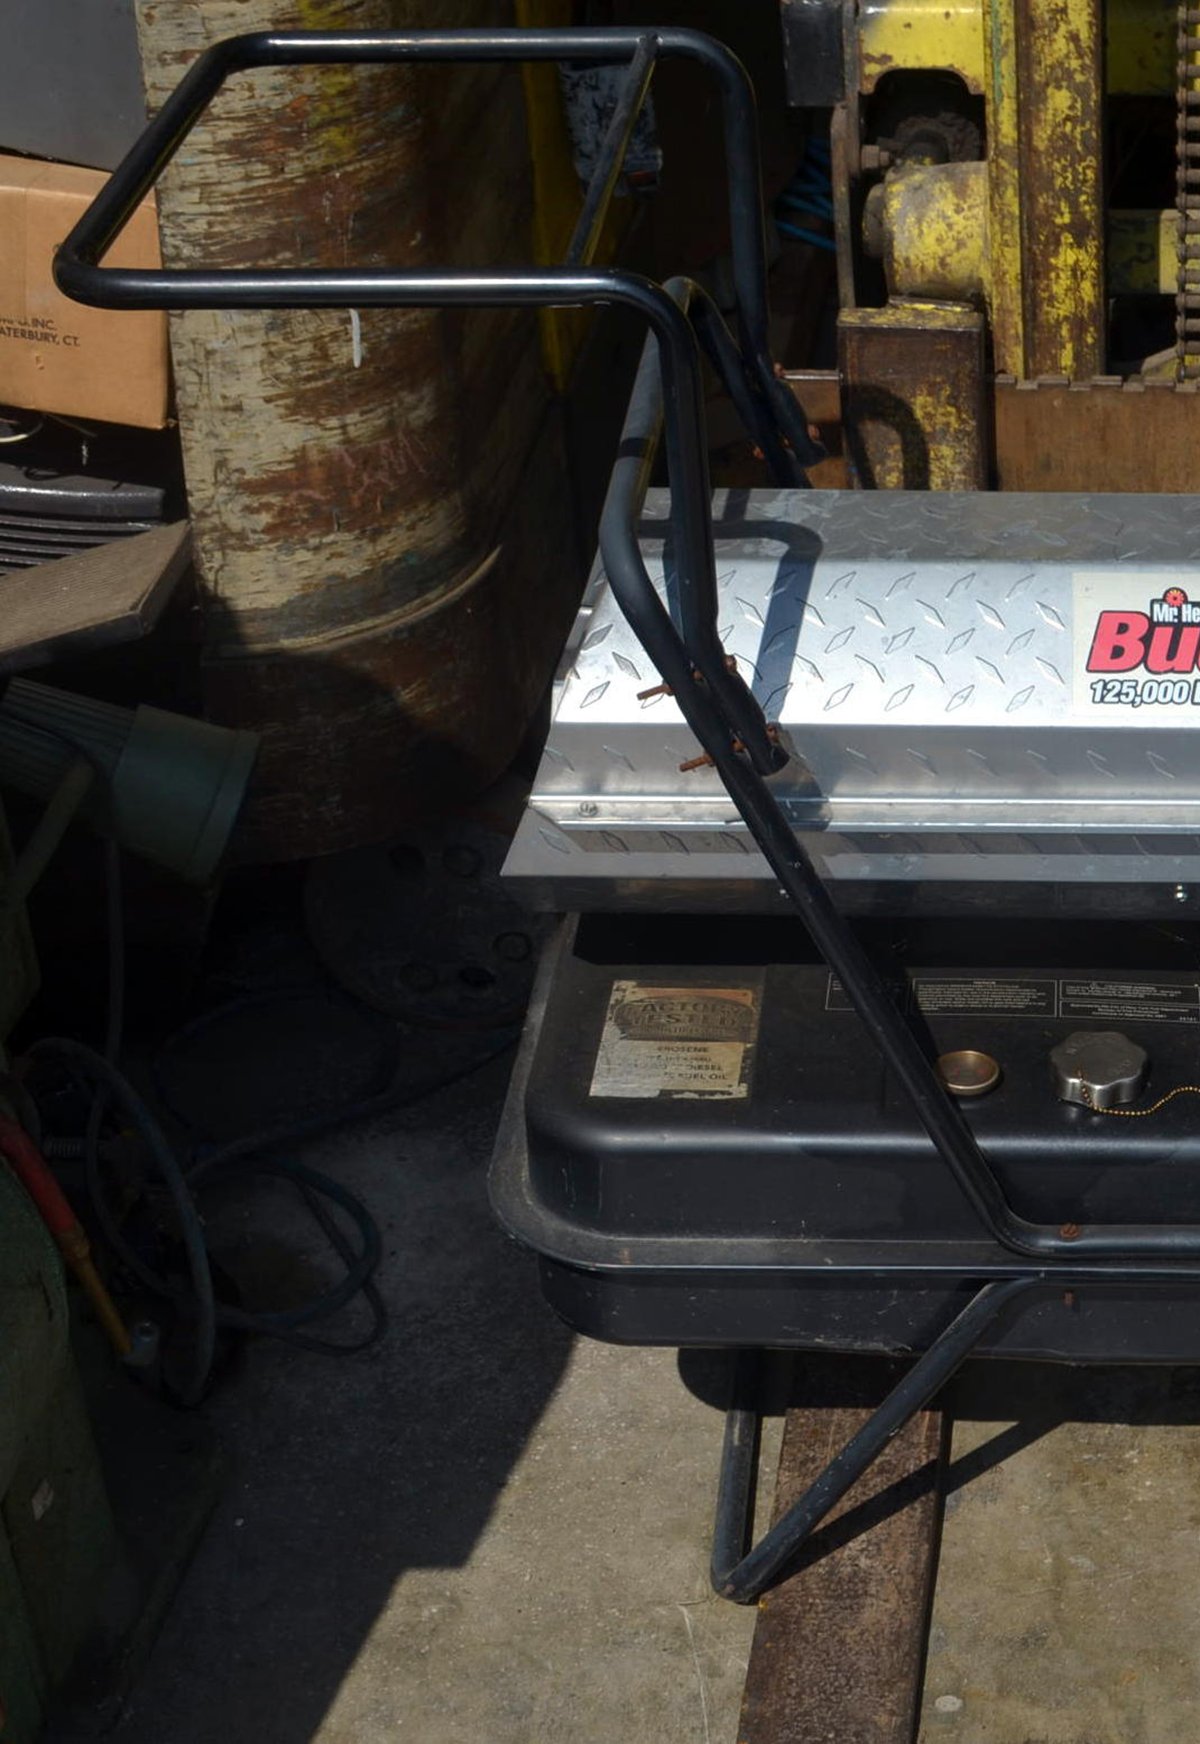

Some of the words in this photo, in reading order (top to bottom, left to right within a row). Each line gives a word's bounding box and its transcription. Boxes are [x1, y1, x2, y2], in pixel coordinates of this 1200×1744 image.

[32, 318, 57, 330] INC.
[0, 326, 60, 345] ATERBURY,
[1152, 603, 1178, 623] Mr.
[1091, 679, 1191, 708] 125,000
